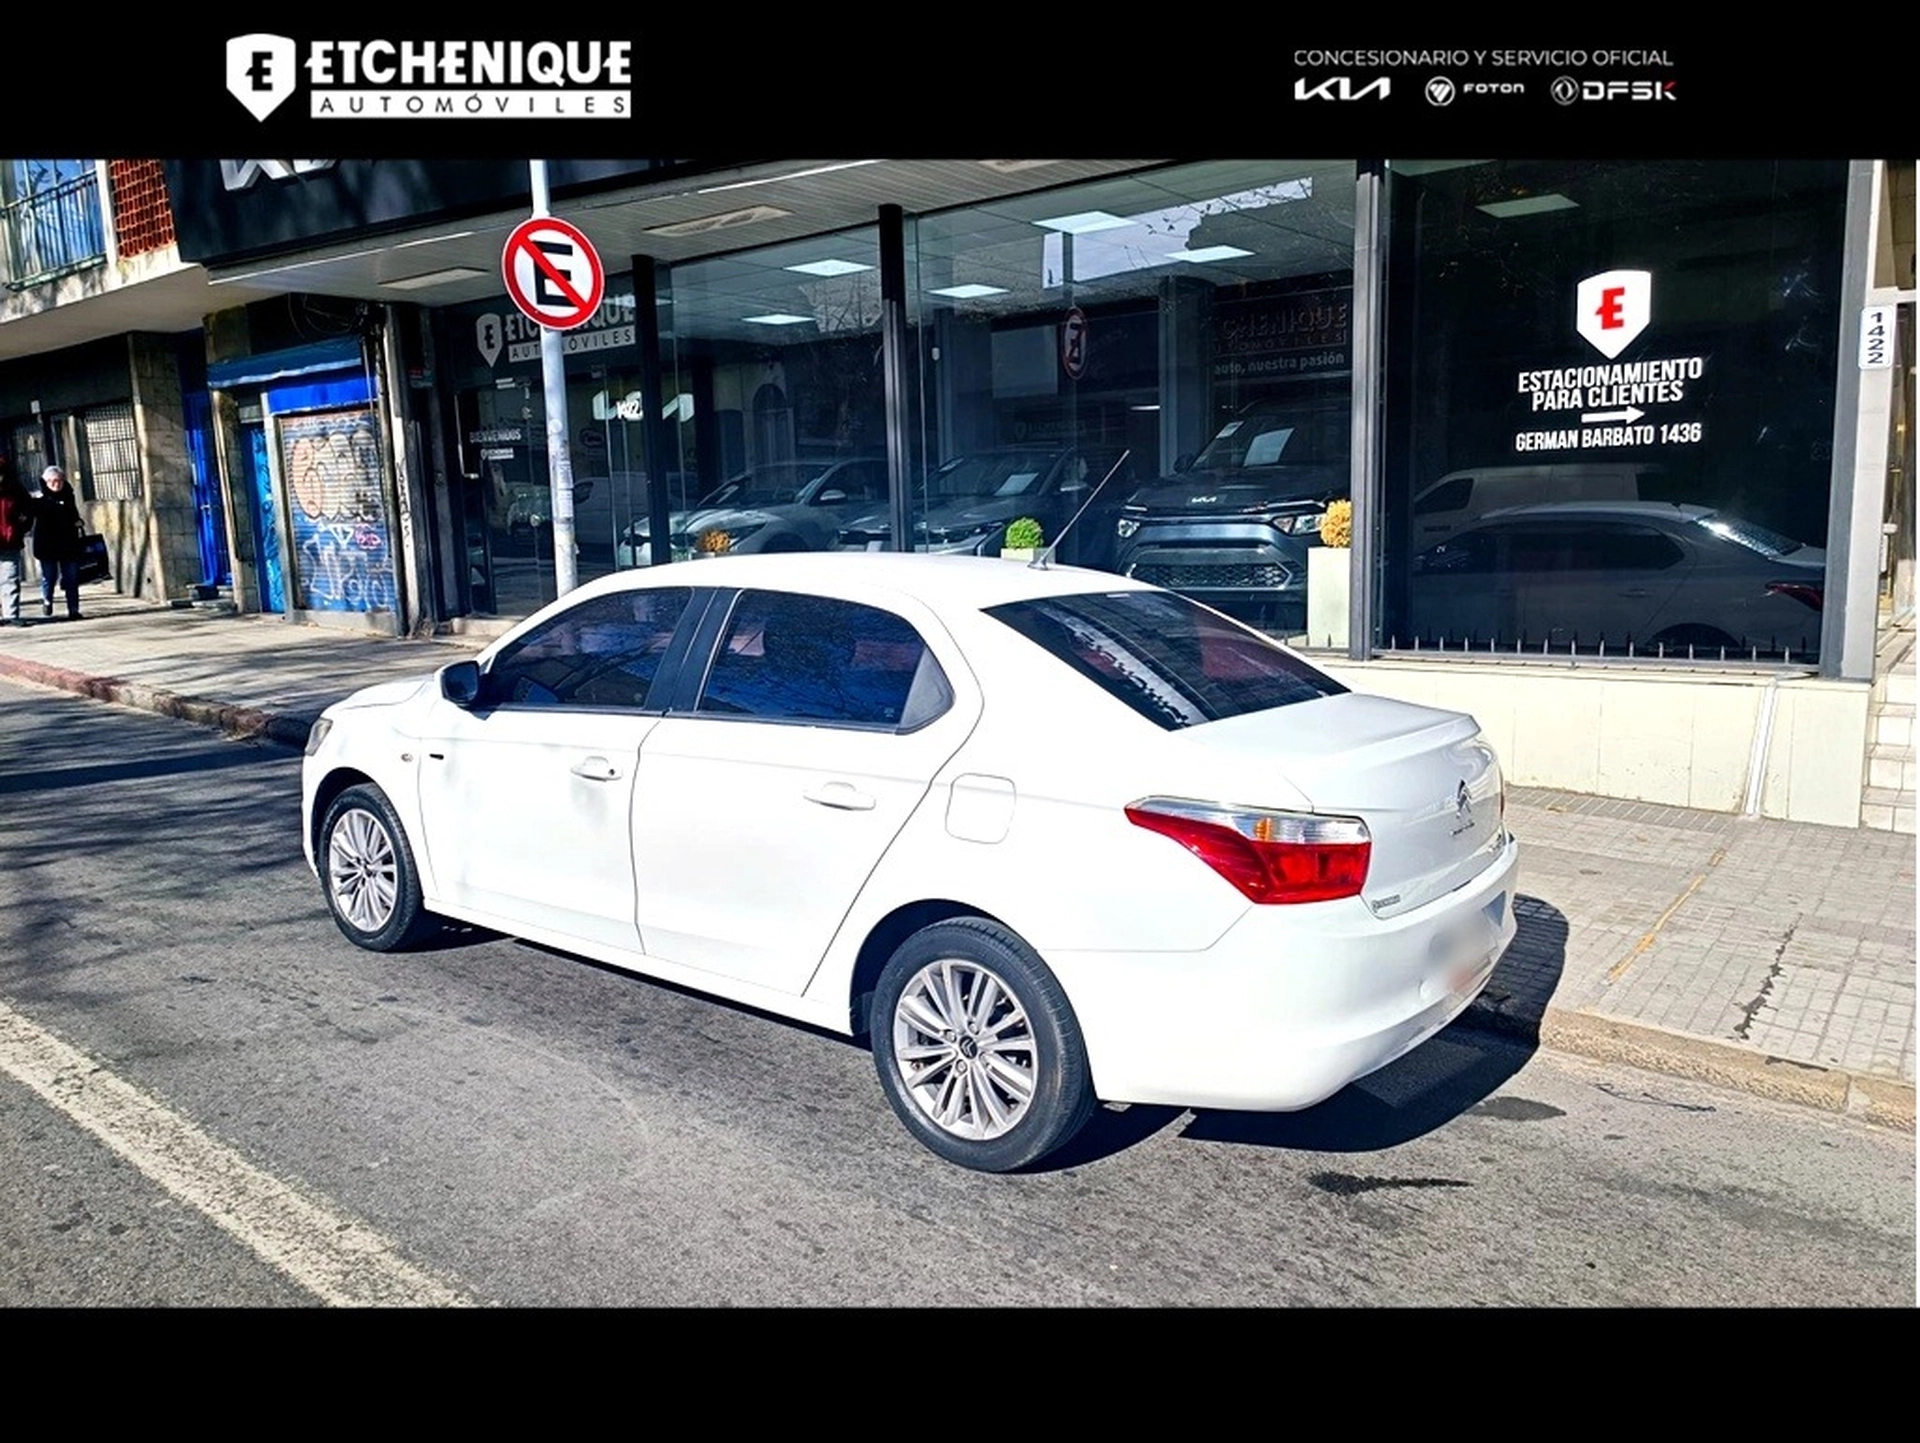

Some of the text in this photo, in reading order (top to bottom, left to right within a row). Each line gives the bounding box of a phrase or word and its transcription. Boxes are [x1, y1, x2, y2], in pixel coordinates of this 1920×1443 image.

[534, 240, 576, 307] E
[1595, 287, 1625, 330] E
[1867, 312, 1885, 364] 1422
[1247, 357, 1297, 372] nuestra
[1300, 351, 1345, 371] pasión
[1518, 357, 1703, 392] ESTACIONAMIENTO
[1532, 380, 1683, 412] PARA CLIENTES
[1515, 423, 1702, 451] GERMAN BARBATO 1436
